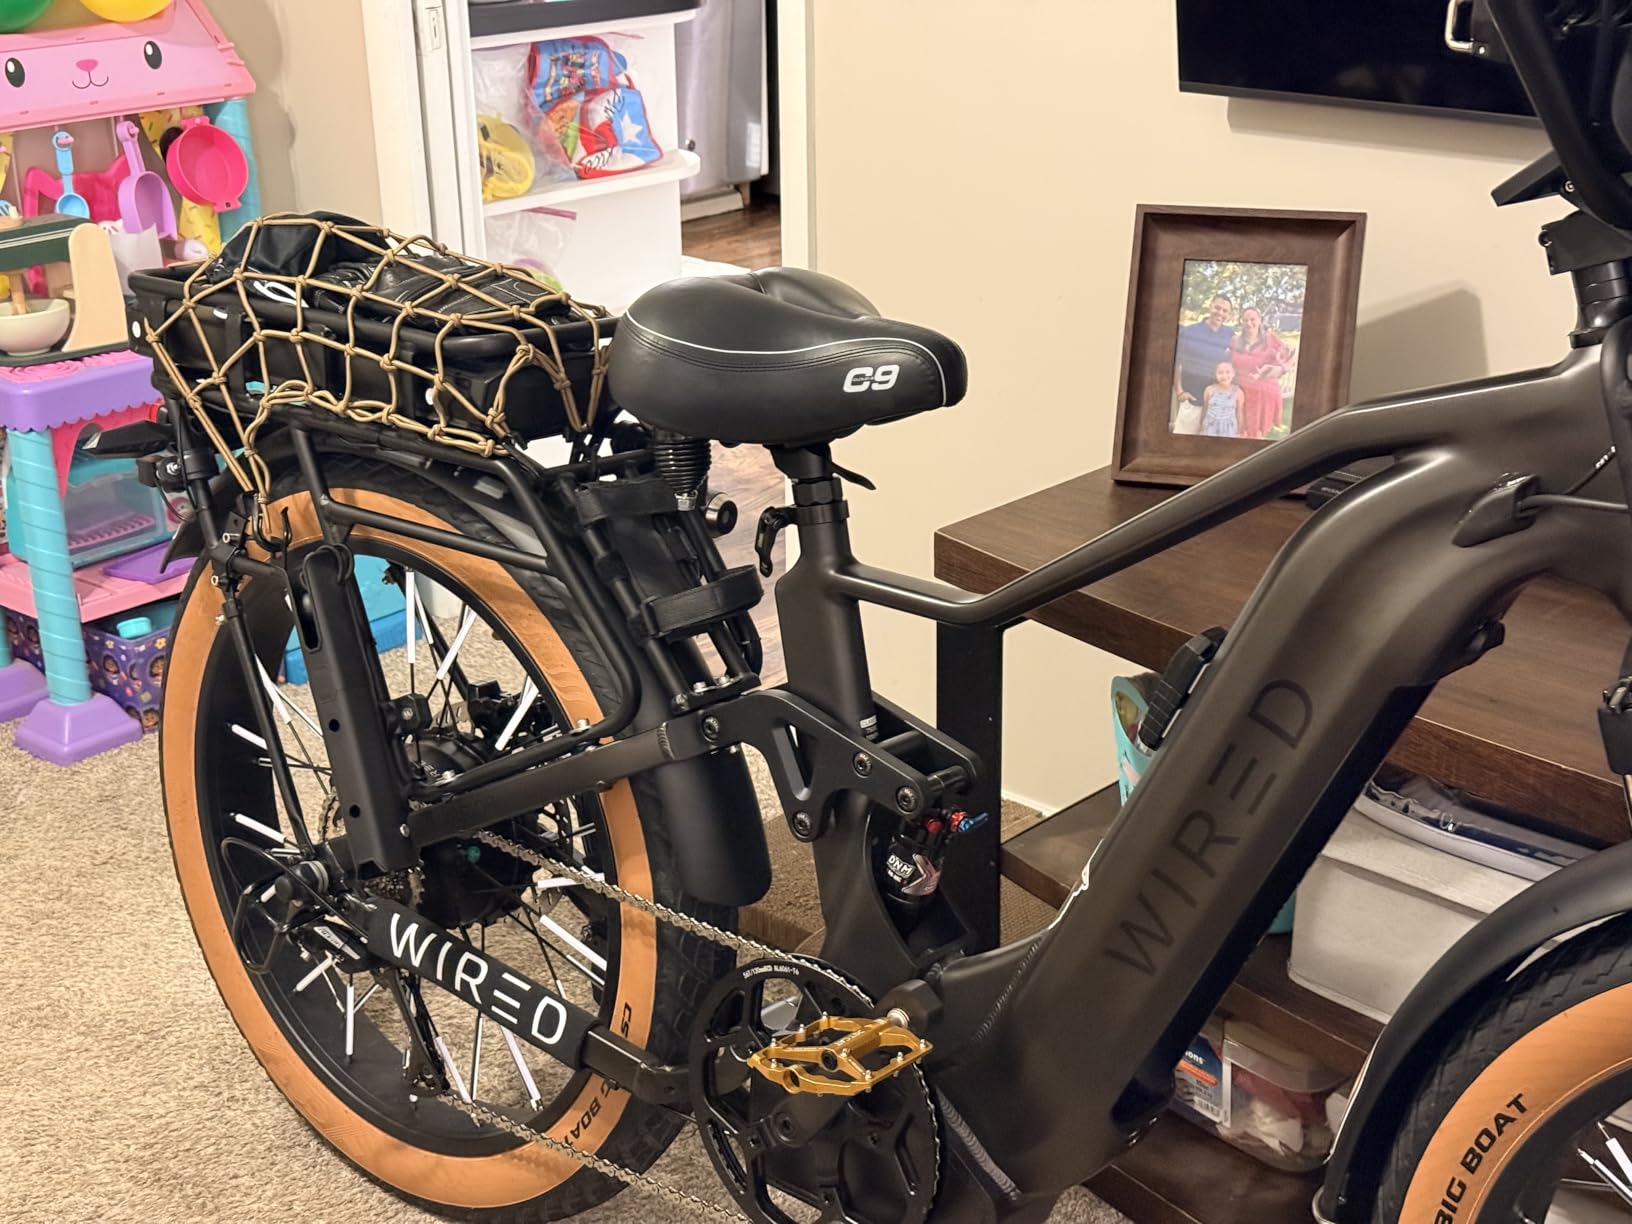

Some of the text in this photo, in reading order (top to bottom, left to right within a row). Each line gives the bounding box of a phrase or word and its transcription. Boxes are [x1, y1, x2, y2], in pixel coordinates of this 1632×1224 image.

[843, 364, 900, 393] C9
[887, 854, 915, 876] DNM
[1103, 679, 1313, 977] WIRED
[390, 912, 567, 1045] WIRED
[1460, 1093, 1528, 1175] BOAT
